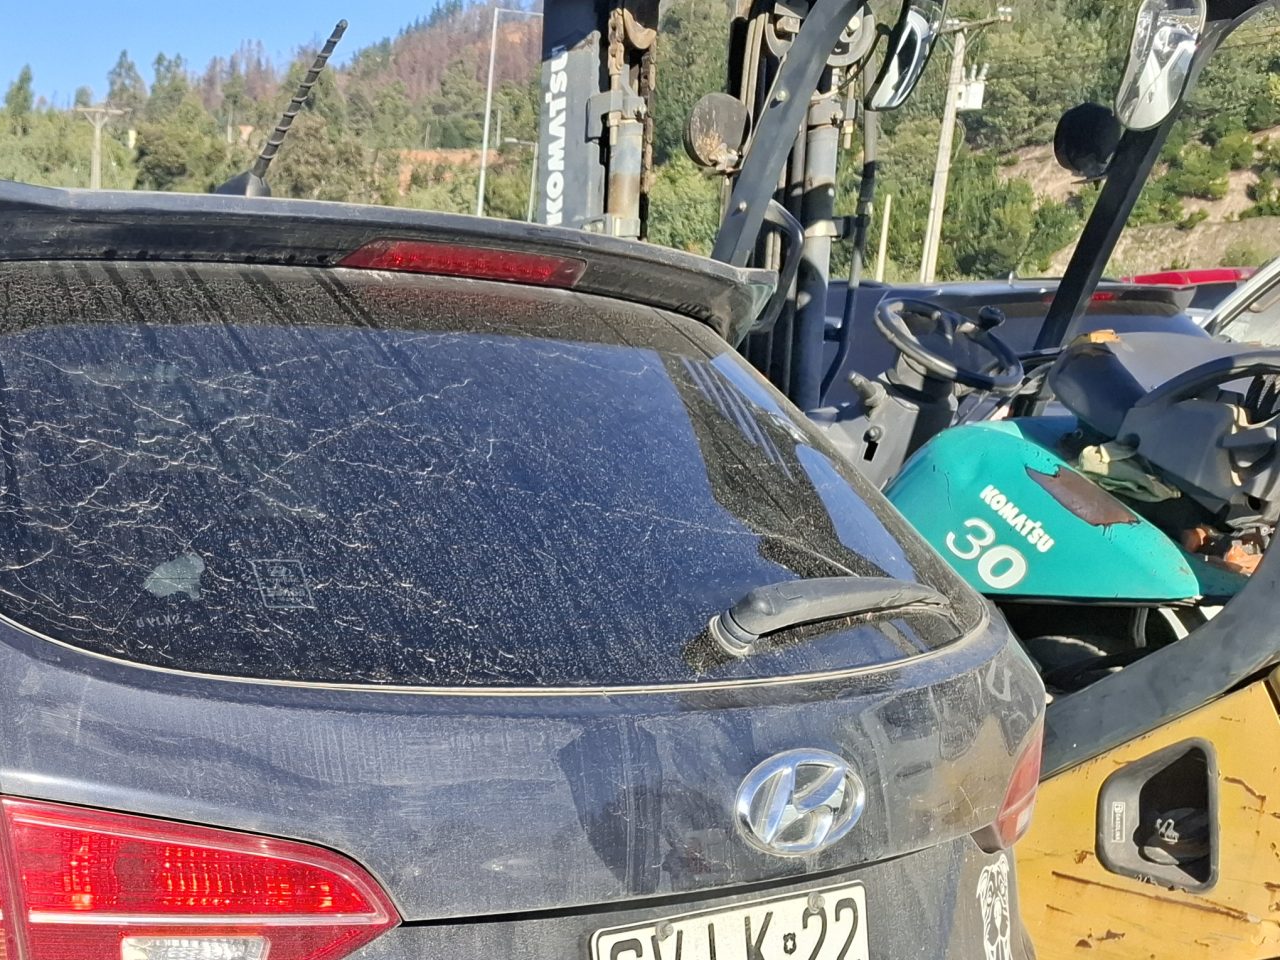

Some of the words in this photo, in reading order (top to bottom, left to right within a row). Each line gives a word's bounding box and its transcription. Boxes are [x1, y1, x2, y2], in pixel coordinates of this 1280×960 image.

[545, 44, 568, 226] KOMATSU
[945, 517, 1027, 590] 30
[979, 484, 1055, 553] KOMATSU
